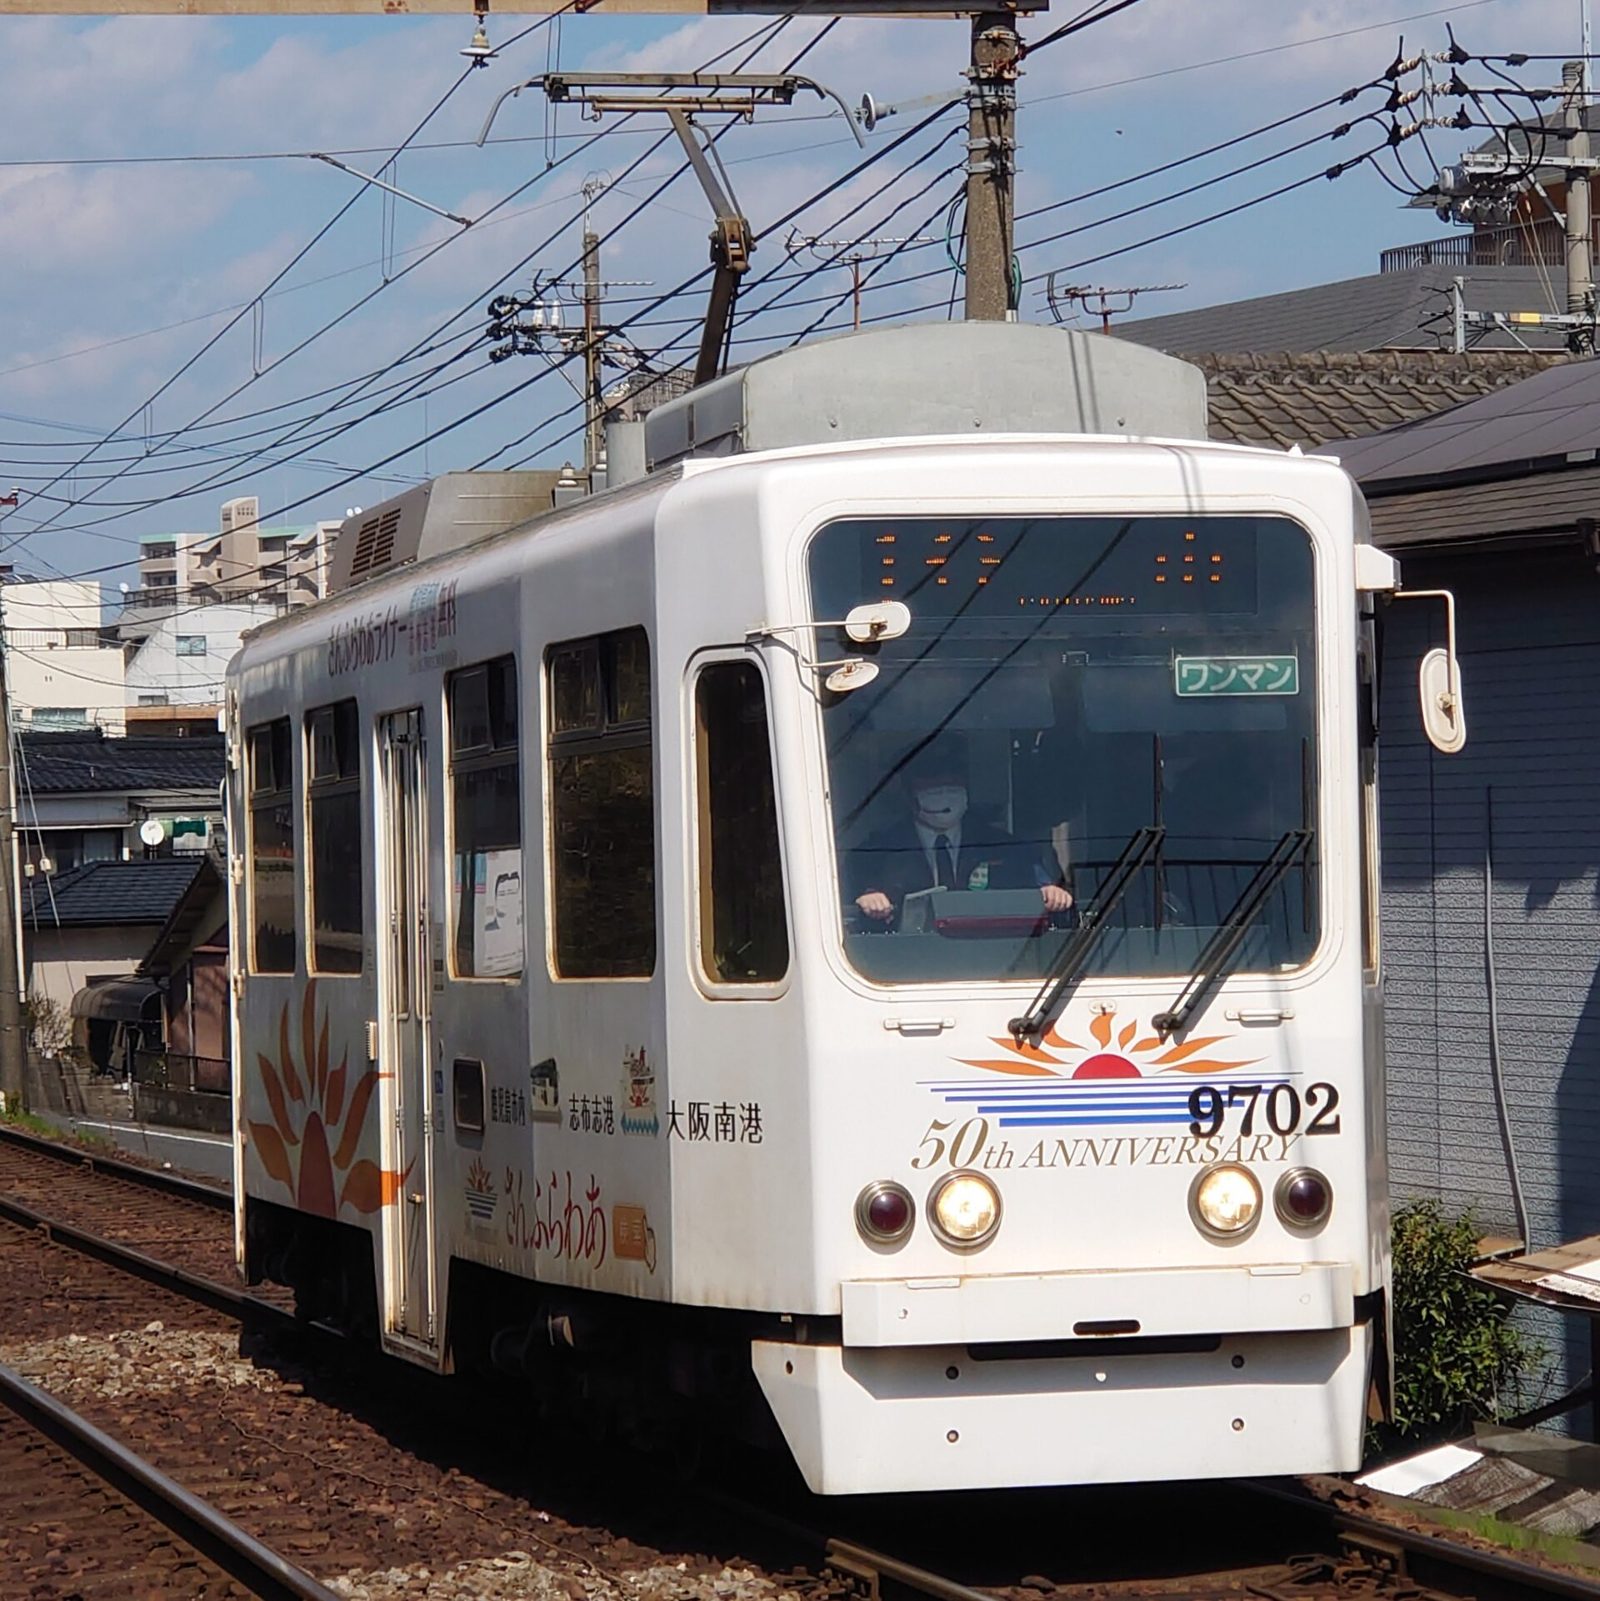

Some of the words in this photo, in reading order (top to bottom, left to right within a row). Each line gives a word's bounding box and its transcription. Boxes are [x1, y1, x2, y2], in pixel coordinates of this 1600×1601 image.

[1181, 662, 1294, 692] ワンマン
[568, 1092, 616, 1137] 志布志港
[665, 1099, 764, 1145] 大阪南港
[1188, 1082, 1342, 1138] 9702
[911, 1117, 1015, 1170] 50th
[1018, 1133, 1302, 1168] ANNIVERSARY
[503, 1165, 608, 1270] さんふらわあ
